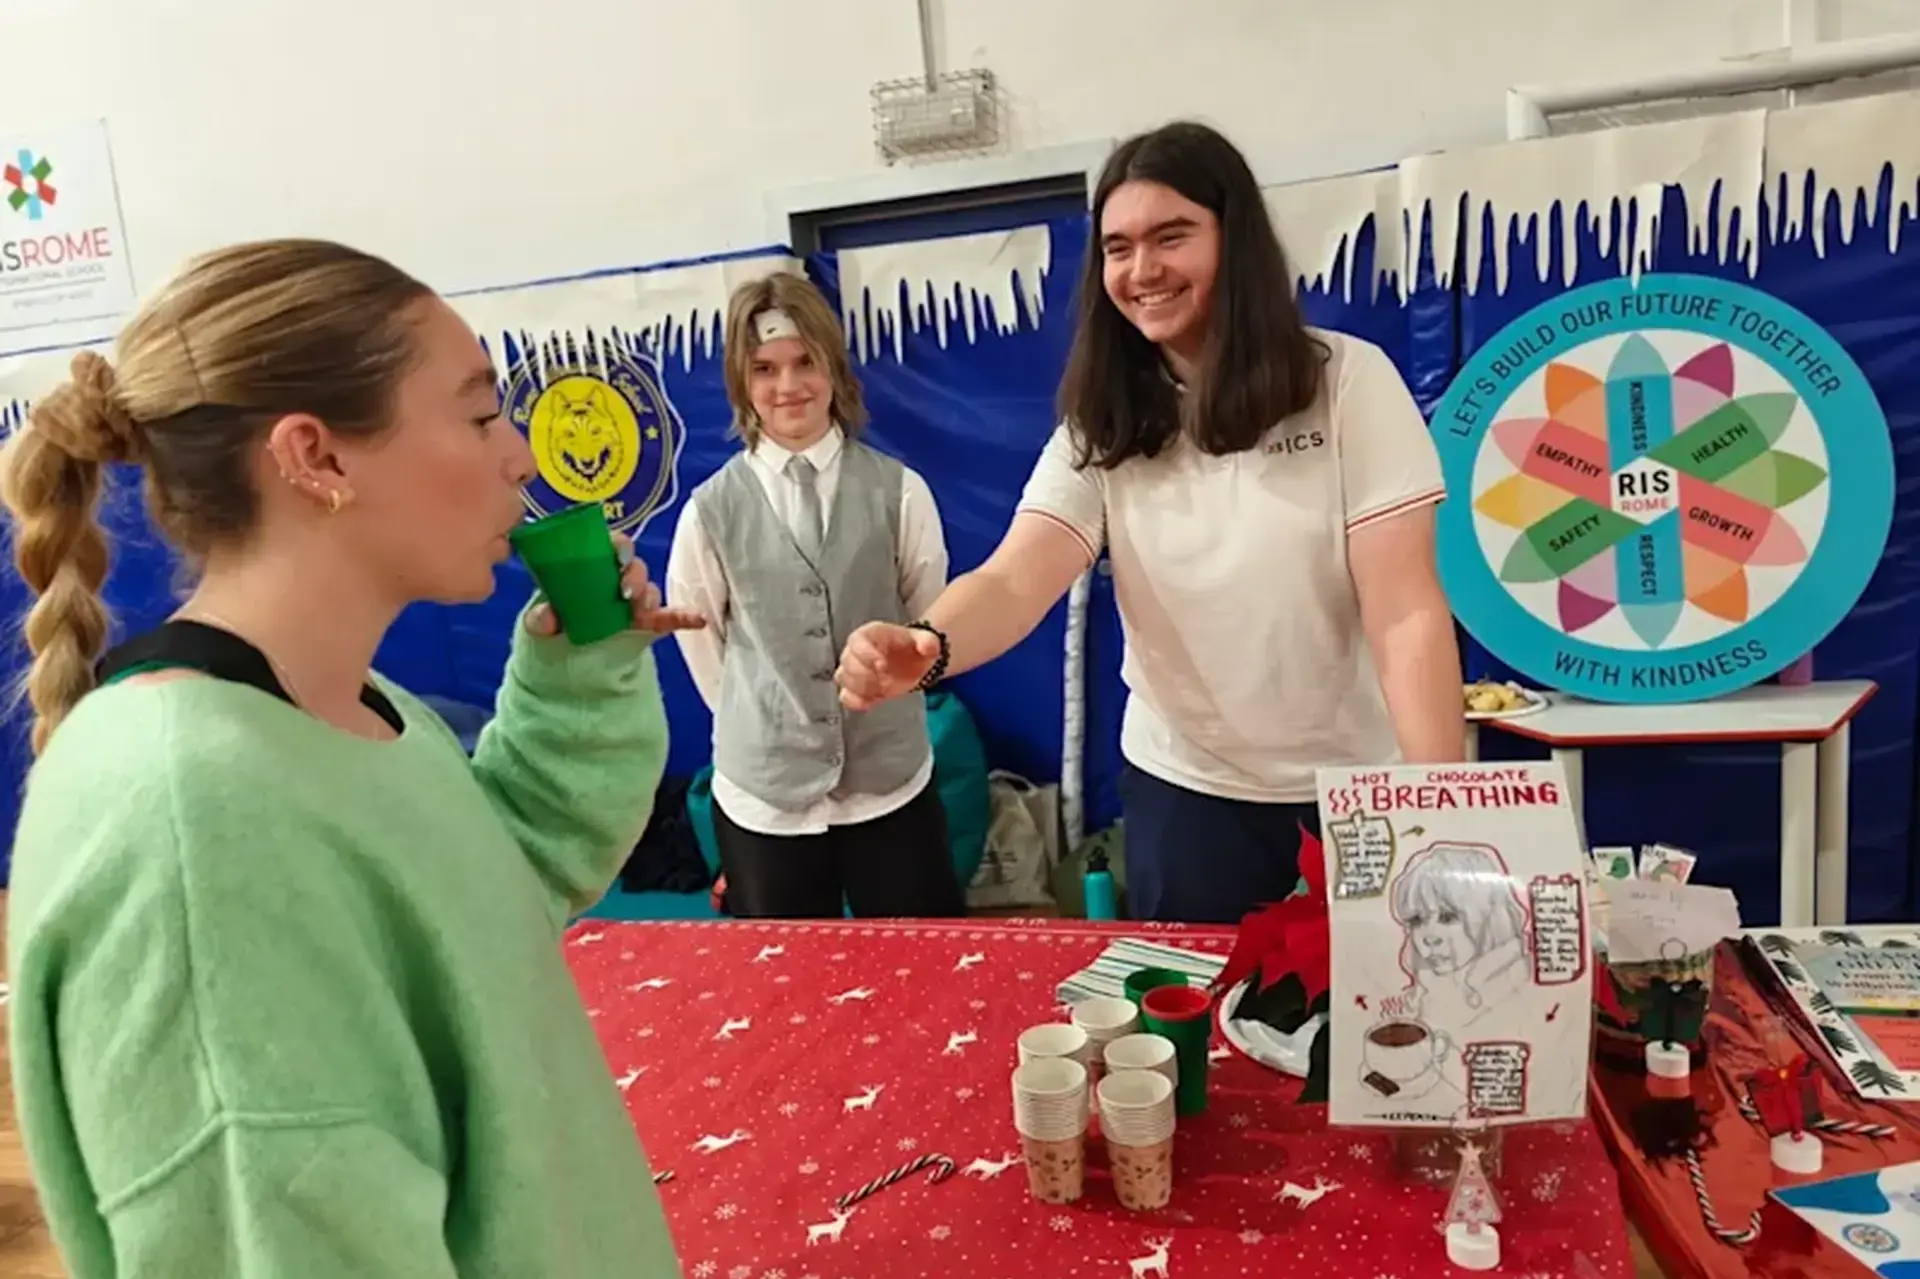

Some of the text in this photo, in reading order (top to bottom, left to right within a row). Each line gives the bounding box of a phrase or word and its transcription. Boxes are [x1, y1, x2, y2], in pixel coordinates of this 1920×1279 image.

[1450, 293, 1842, 437] LET'S BUILD OUR FUTURE TOGETHER
[1630, 381, 1648, 452] KINDNESS
[1535, 442, 1604, 479] EMPATHY
[1690, 422, 1749, 465] HEALTH
[1617, 470, 1671, 497] RIS
[1620, 497, 1670, 512] ROME
[1548, 515, 1602, 552] SAFETY
[1687, 506, 1754, 541] GROWTH
[1640, 534, 1658, 597] RESPECT
[1554, 639, 1768, 689] WITH KINDNESS
[1351, 769, 1529, 785] HOT CHOCOLATE
[1371, 782, 1559, 813] BREATHING
